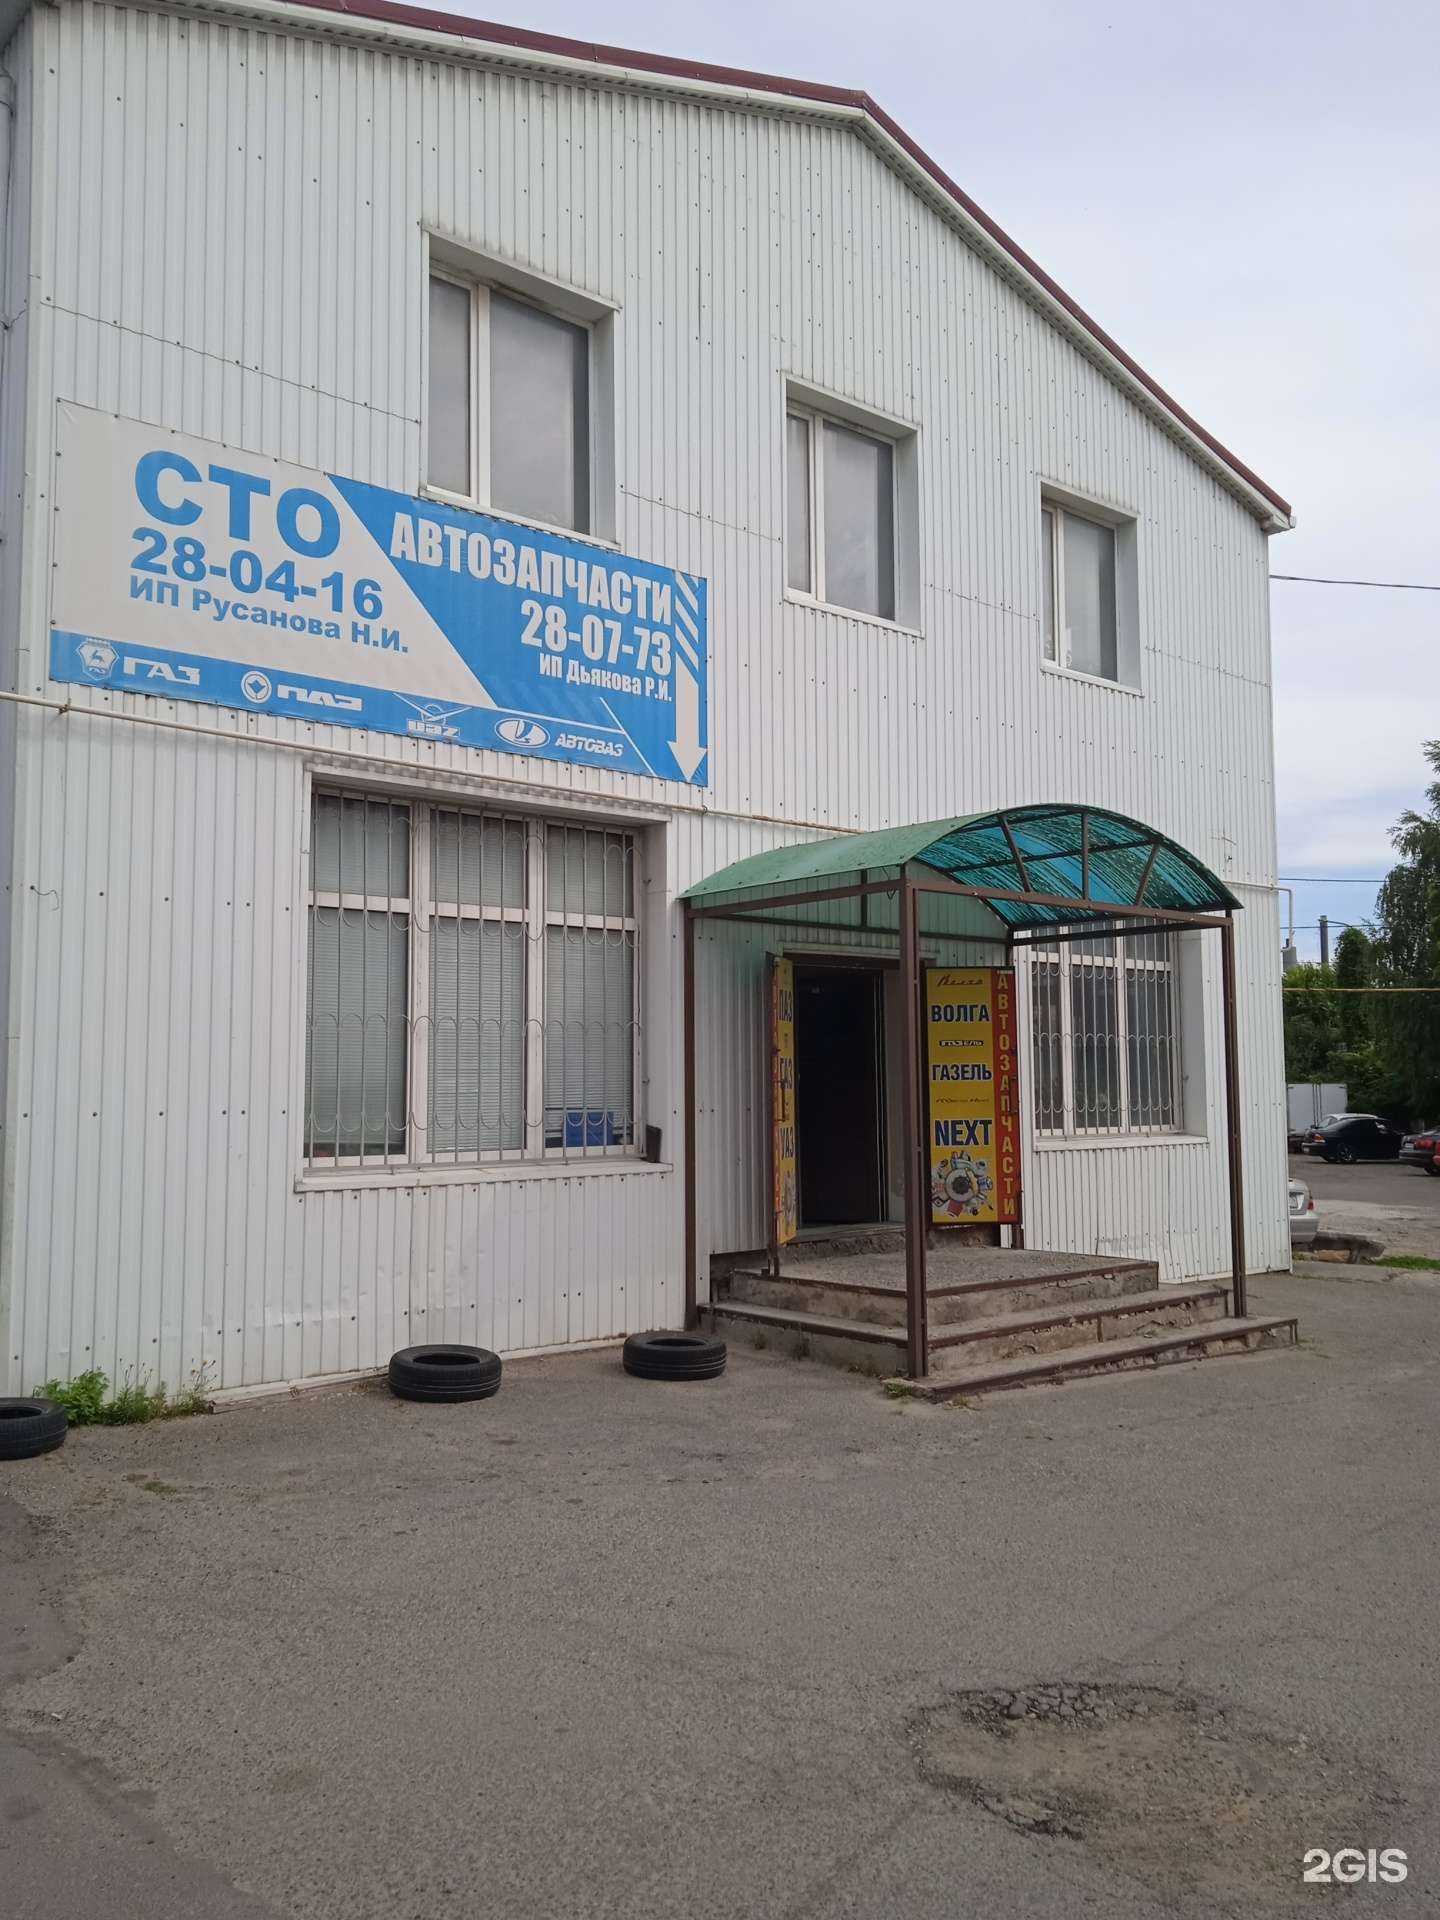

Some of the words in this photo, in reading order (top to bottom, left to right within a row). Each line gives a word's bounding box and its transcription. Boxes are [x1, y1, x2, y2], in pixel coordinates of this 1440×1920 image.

[134, 449, 341, 560] СТО
[130, 526, 383, 621] 28-04-16
[390, 511, 672, 626] АВТОЗАПЧАСТИ
[130, 575, 180, 607] ИП
[192, 590, 341, 640] Русанова
[351, 621, 409, 653] Н.И.
[521, 599, 672, 677] 28-07-73
[123, 655, 201, 686] ГАЗ
[277, 684, 363, 712] ПАЗ
[539, 652, 564, 680] ИП
[566, 659, 643, 696] Дьякова
[645, 678, 673, 702] Р.И.
[931, 1004, 990, 1022] ВОЛГА
[931, 1063, 992, 1081] ГАЗЕЛЬ
[997, 976, 1015, 1216] АВТОЗАПЧАСТИ
[935, 1119, 992, 1146] NEXT
